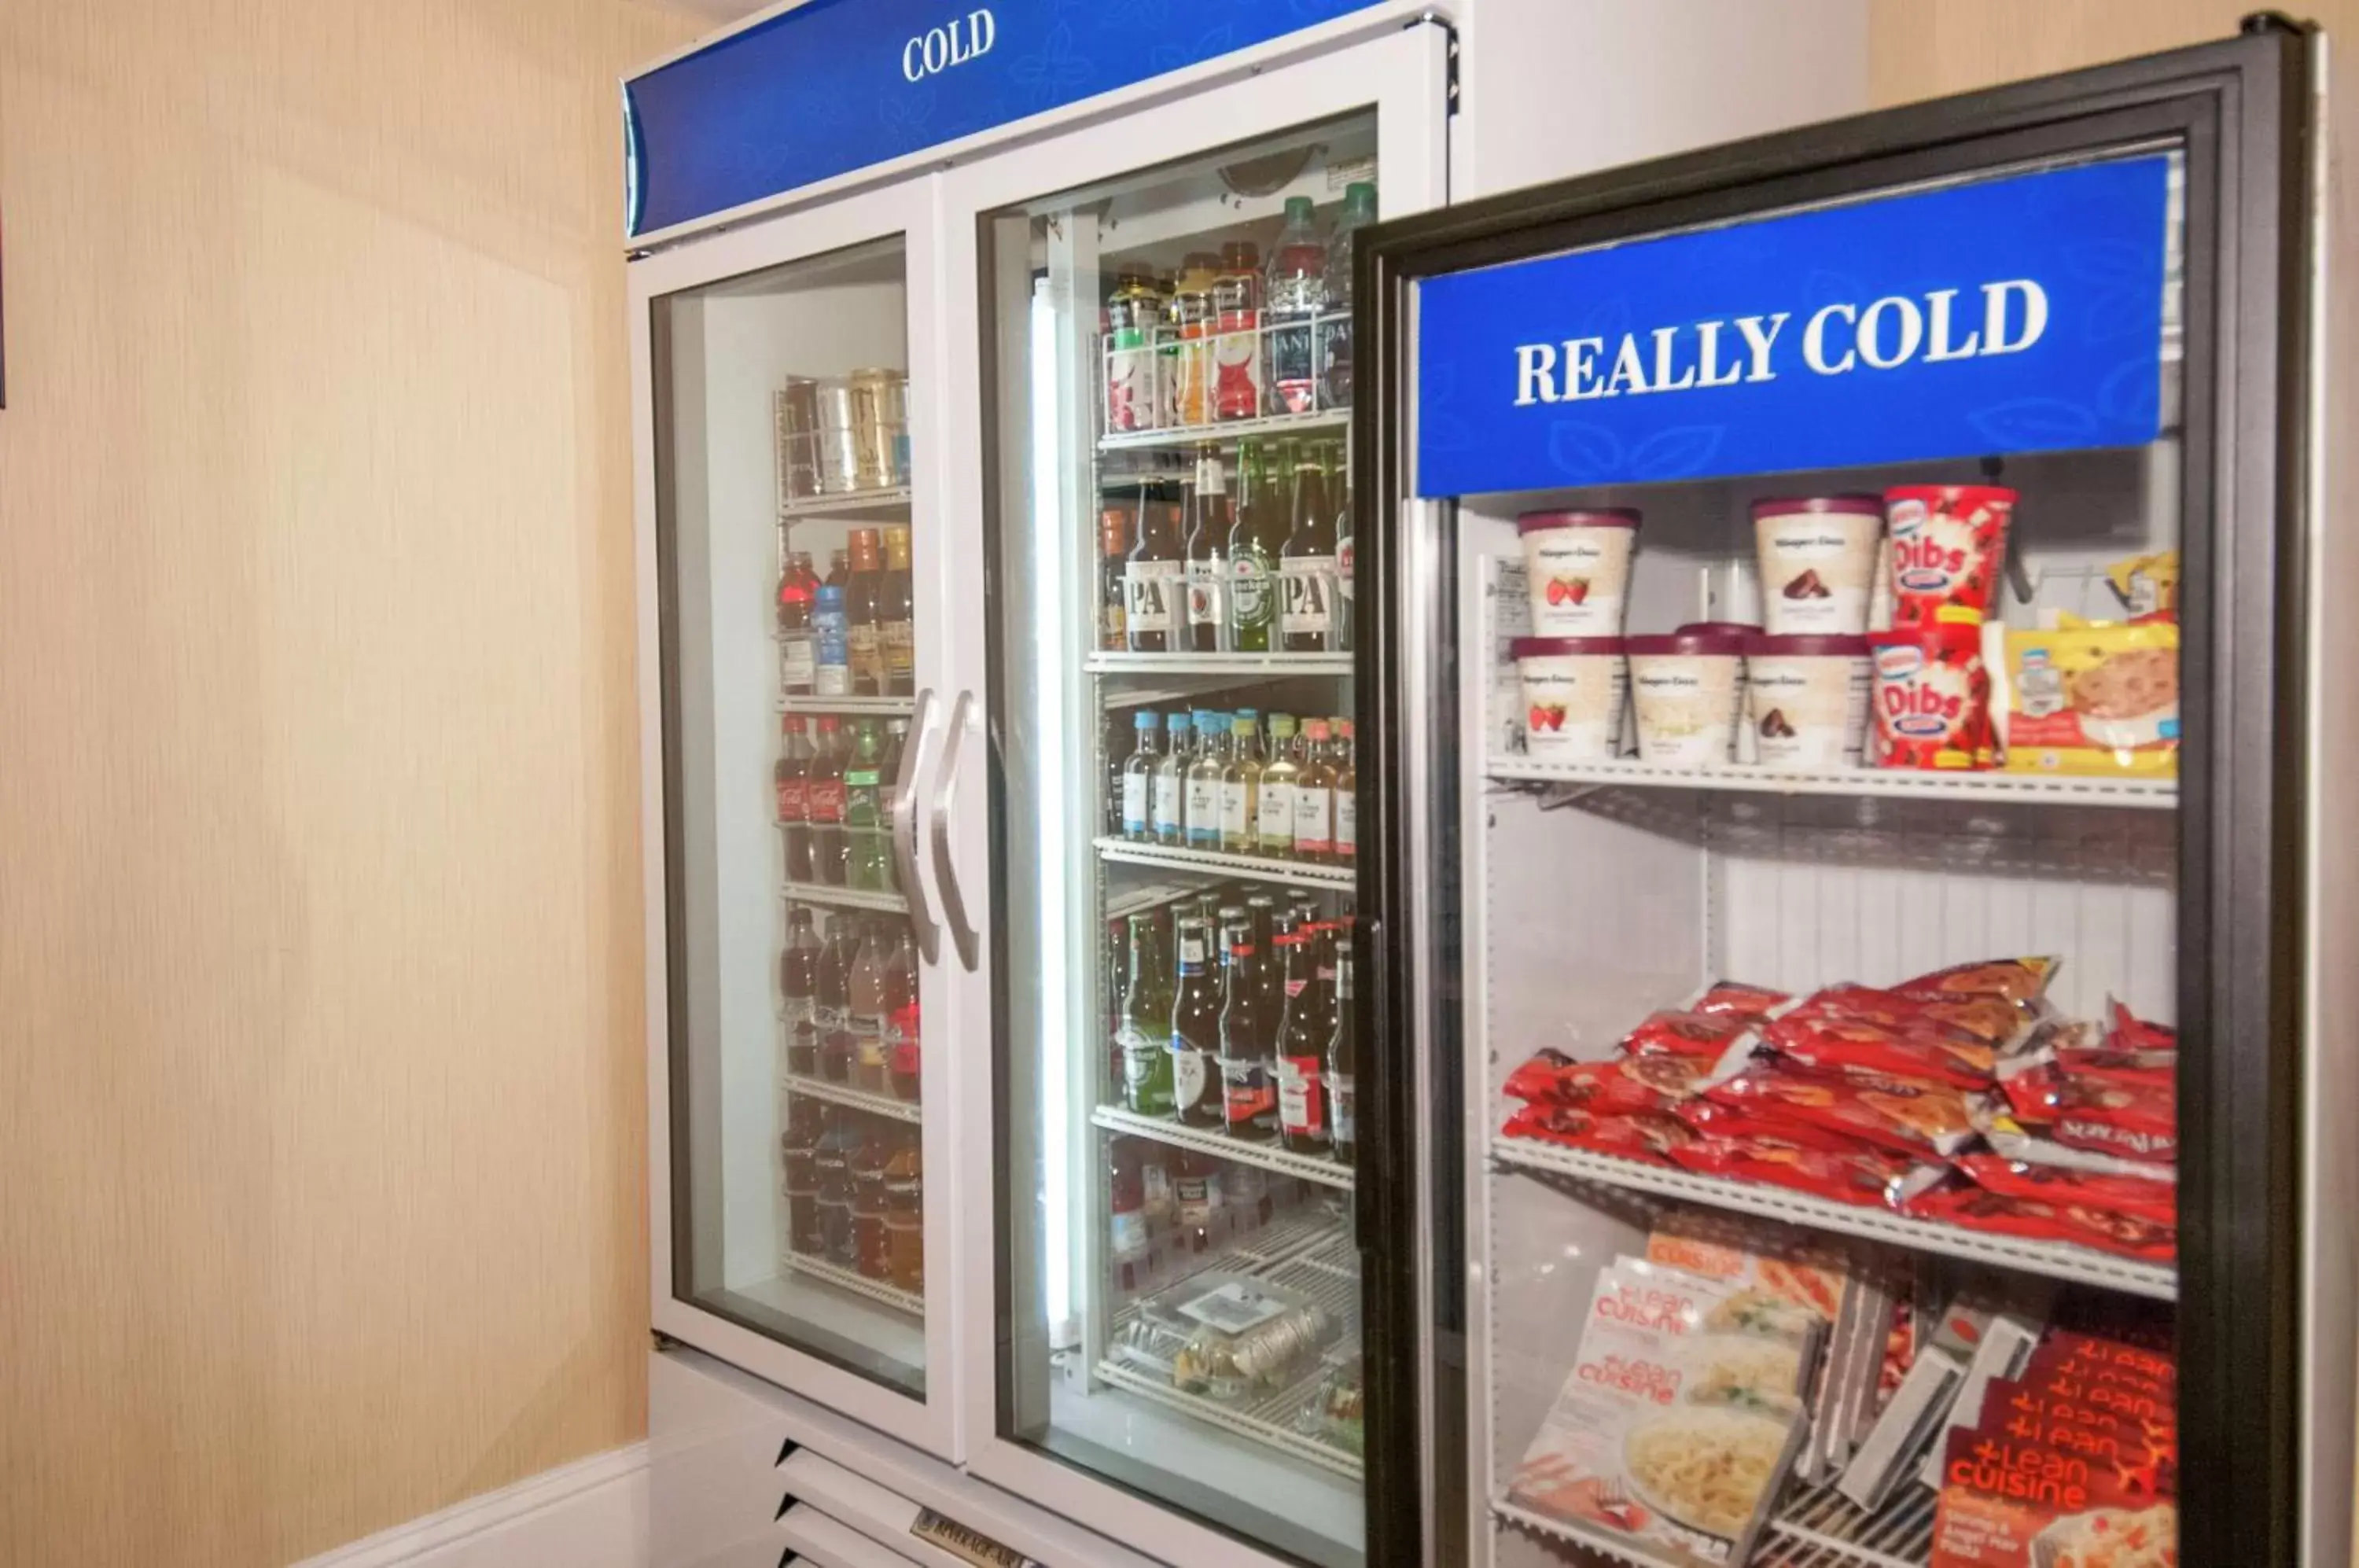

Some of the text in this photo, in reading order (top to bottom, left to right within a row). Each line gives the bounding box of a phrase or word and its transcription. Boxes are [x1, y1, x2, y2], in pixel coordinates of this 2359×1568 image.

[903, 9, 995, 83] COLD
[1513, 278, 2049, 407] REALLY COLD
[1883, 679, 1963, 720] Dibs
[2002, 1445, 2090, 1486] Lean
